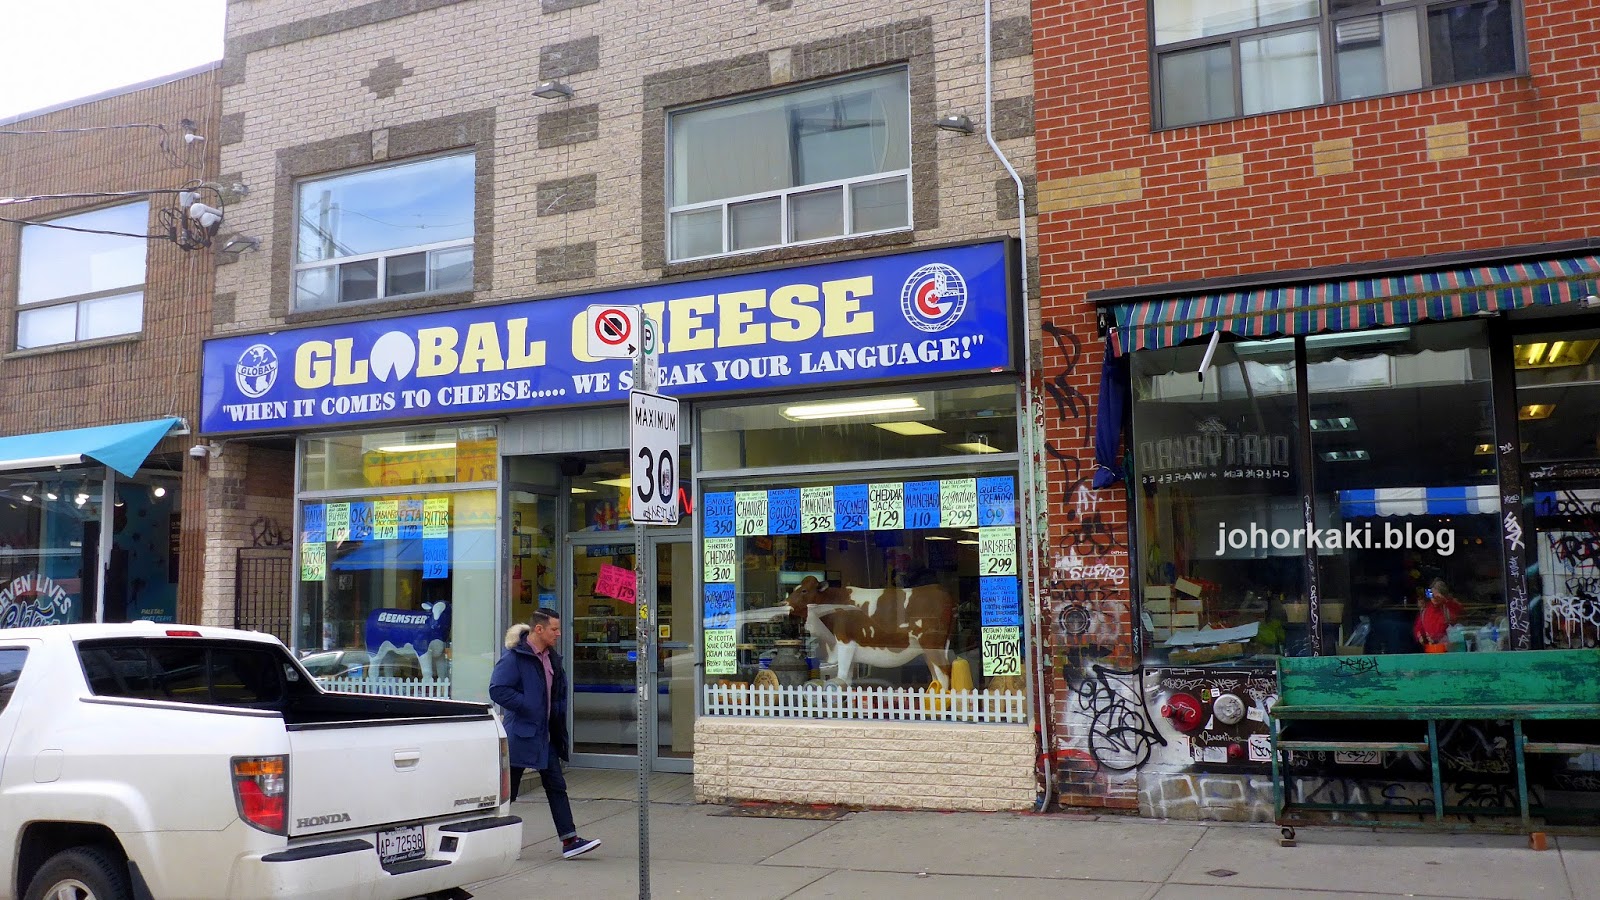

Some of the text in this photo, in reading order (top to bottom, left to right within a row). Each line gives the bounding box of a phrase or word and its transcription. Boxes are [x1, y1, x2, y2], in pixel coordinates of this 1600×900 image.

[294, 318, 546, 390] GLOBAL
[240, 363, 275, 377] GLOBAL
[293, 398, 315, 418] IT
[320, 392, 396, 416] COMES
[401, 388, 429, 409] TO
[572, 372, 611, 394] WE
[618, 362, 707, 390] SEAK
[711, 353, 792, 380] YOUR
[635, 406, 676, 432] MAXIMUM
[637, 446, 674, 504] 30
[869, 488, 904, 503] CHEDDAR
[706, 505, 733, 517] BLUE
[769, 505, 798, 520] GOUDA
[872, 500, 895, 511] JACK
[351, 507, 373, 525] OKA
[979, 538, 1016, 554] JARLSBERG
[705, 549, 736, 566] CHEDDAR
[35, 573, 72, 615] LIVES
[377, 611, 428, 625] BEEMSTER
[983, 639, 1020, 658] STILTON
[296, 811, 352, 829] HONDA
